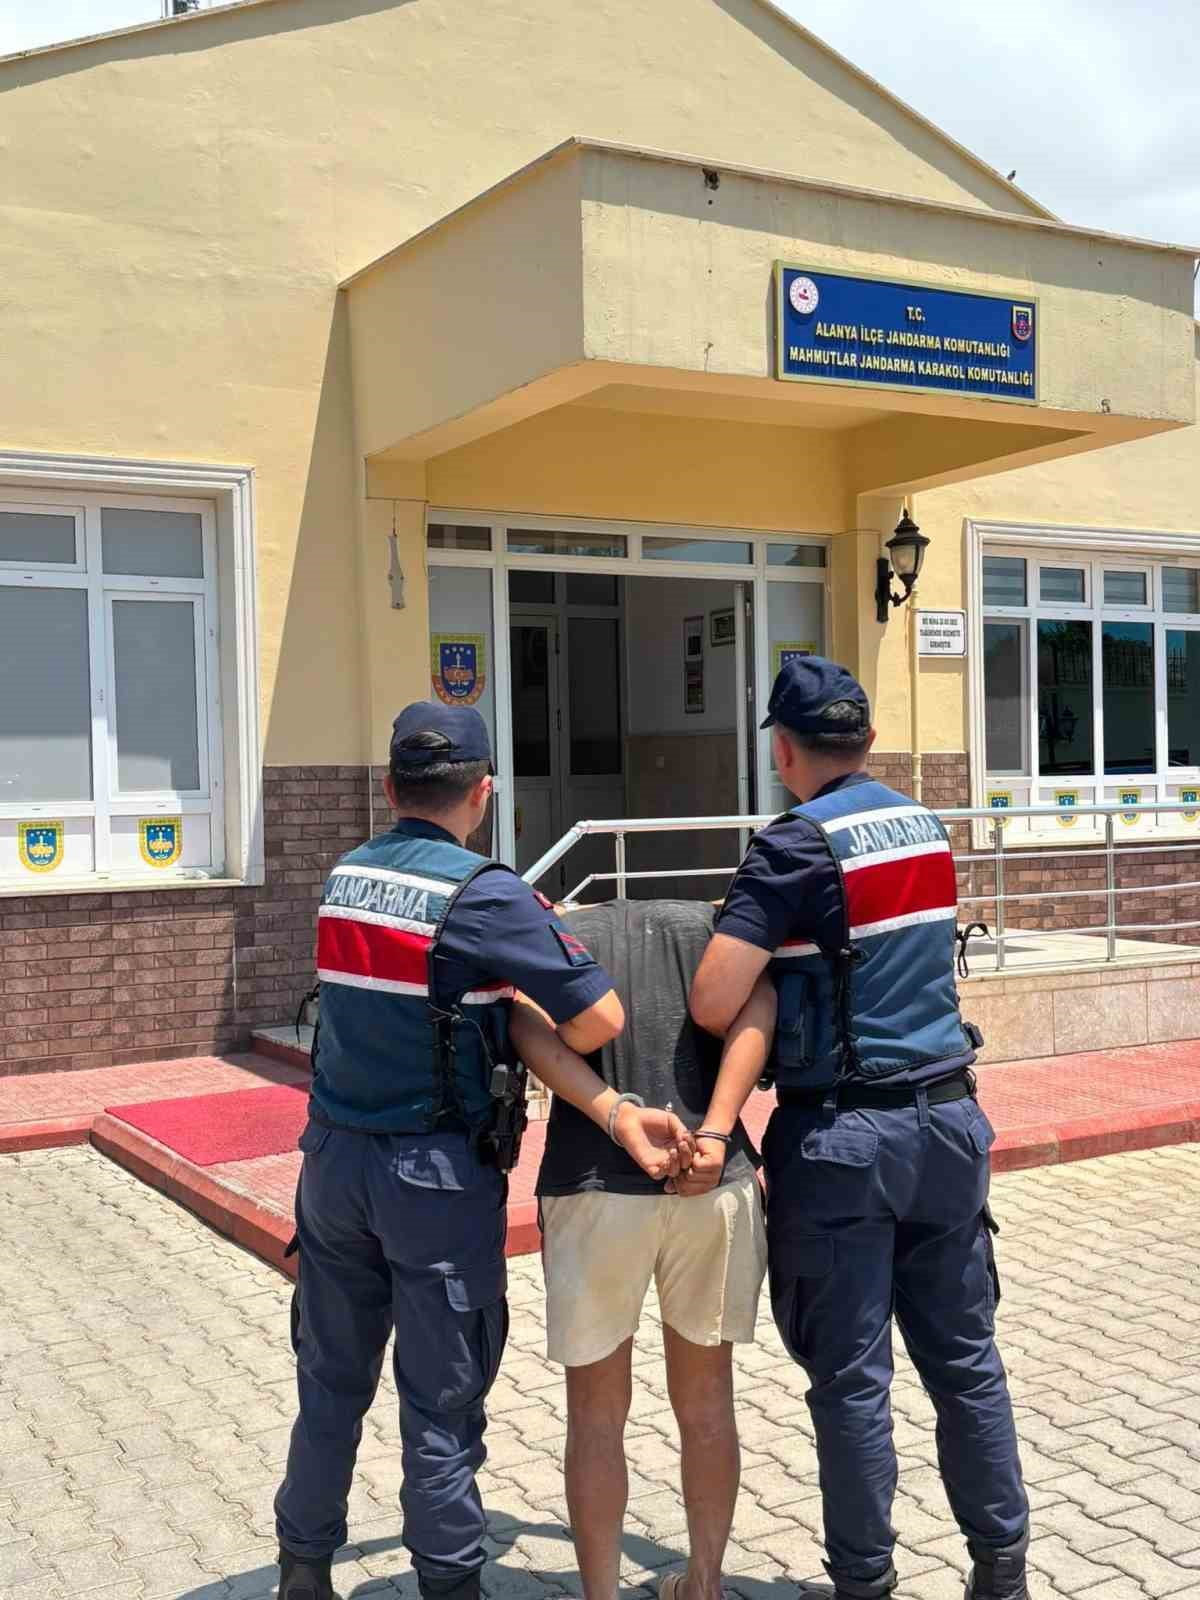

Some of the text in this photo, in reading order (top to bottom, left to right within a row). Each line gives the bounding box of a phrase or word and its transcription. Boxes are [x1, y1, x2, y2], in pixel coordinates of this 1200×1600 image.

[906, 306, 926, 322] T.C.
[815, 321, 1010, 358] ALANYA İLÇE JANDARMA KOMUTANLIĞI
[790, 346, 1033, 386] MAHMUTLAR JANDARMA KARAKOL KOMUTANLIĞI
[848, 814, 943, 855] JANDARMA
[325, 875, 429, 921] JANDARMA
